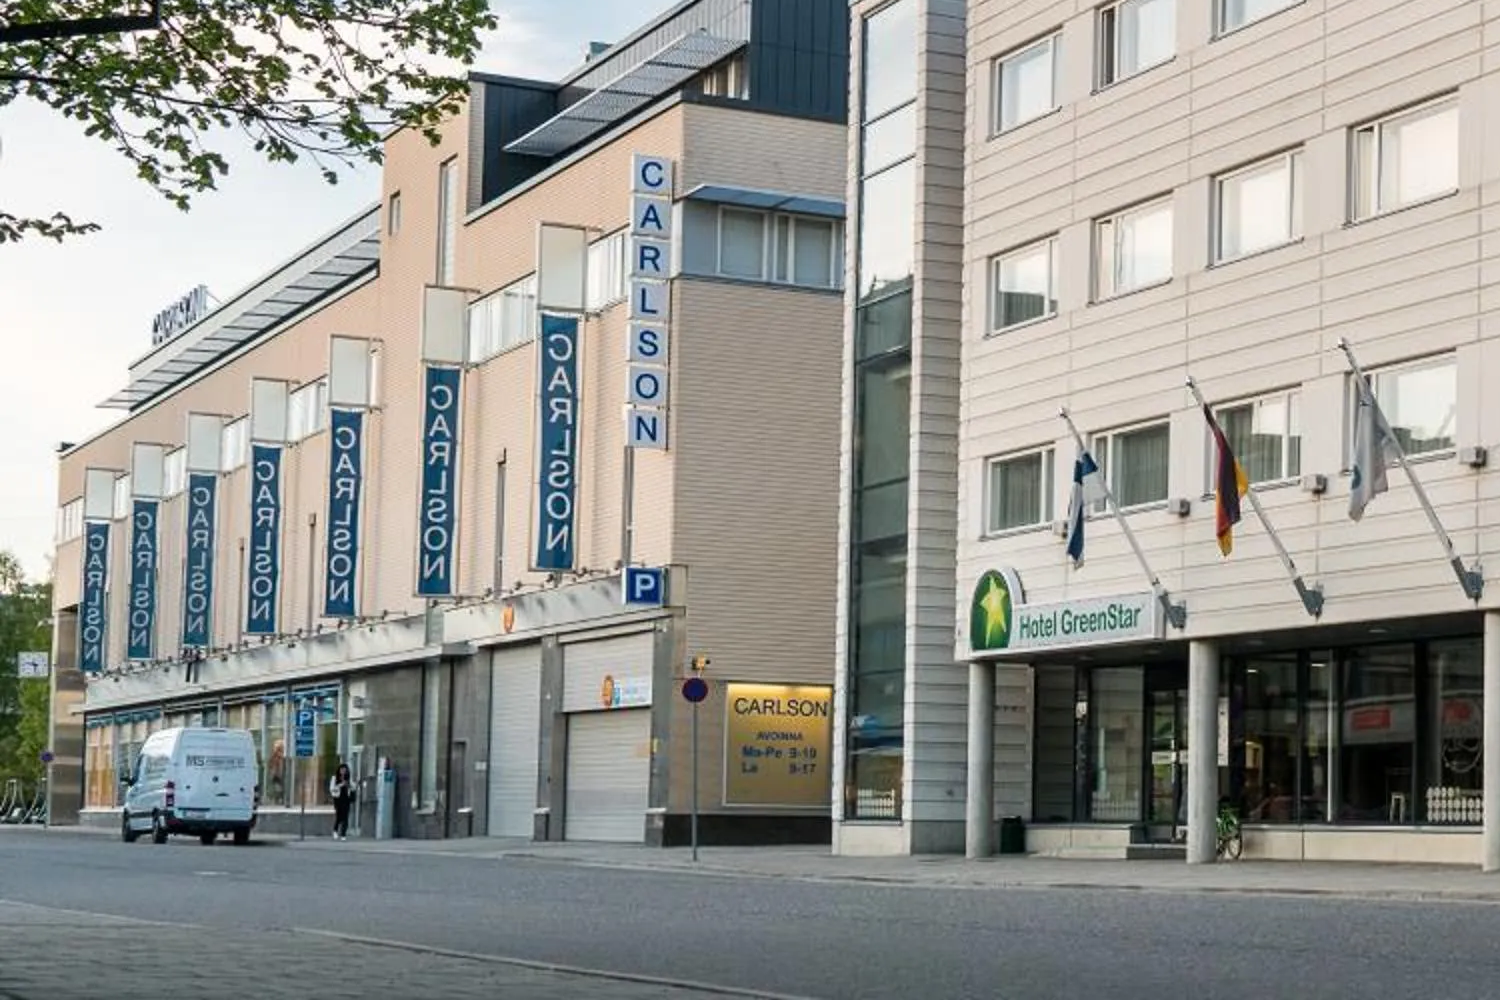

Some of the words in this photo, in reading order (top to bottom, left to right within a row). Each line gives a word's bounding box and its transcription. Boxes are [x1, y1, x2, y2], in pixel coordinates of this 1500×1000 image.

[635, 161, 664, 442] CARLSON
[635, 573, 656, 598] P
[1019, 611, 1057, 640] Hotel
[1061, 603, 1142, 635] GreenStar
[734, 697, 828, 717] CARLSON
